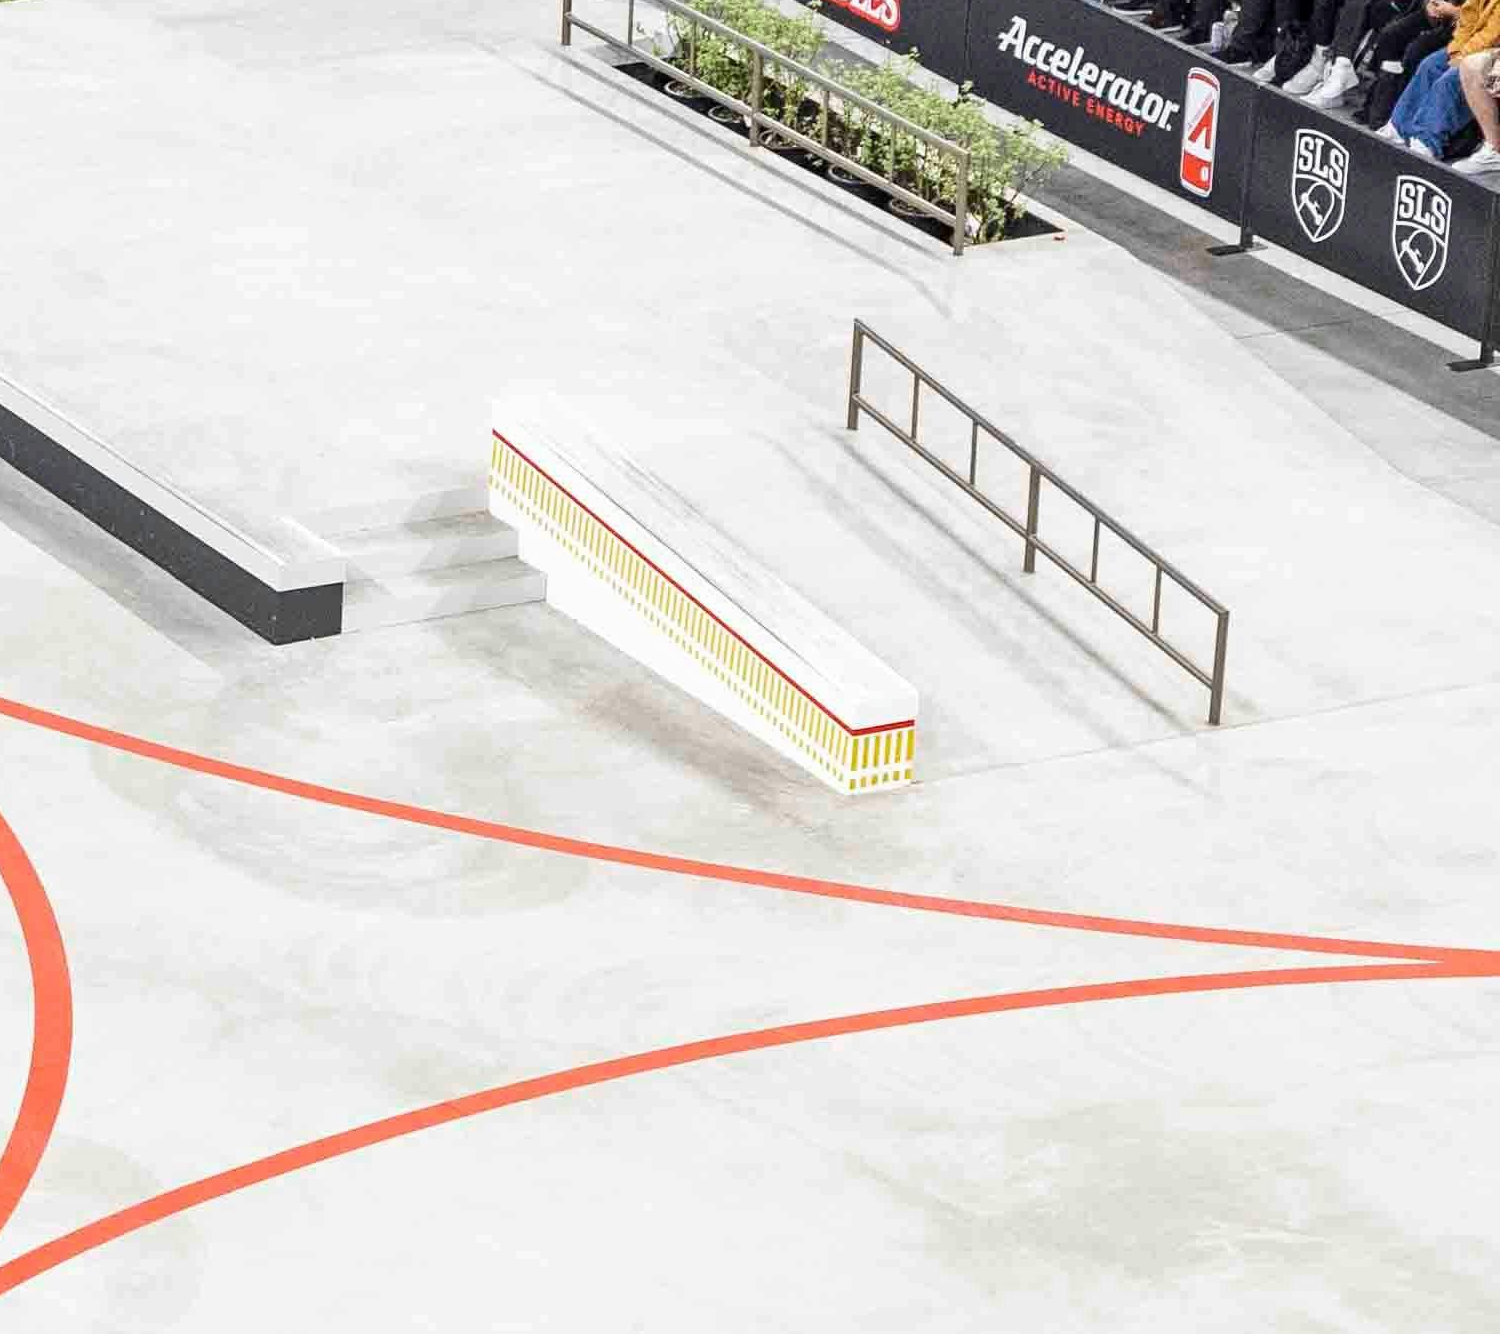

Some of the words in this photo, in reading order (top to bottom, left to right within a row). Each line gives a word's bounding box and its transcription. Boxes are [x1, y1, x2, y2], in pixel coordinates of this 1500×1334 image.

[1026, 69, 1081, 108] ACTIVE
[1085, 96, 1147, 139] ENERGY
[1299, 135, 1344, 188] SLS
[1399, 182, 1447, 236] SLS
